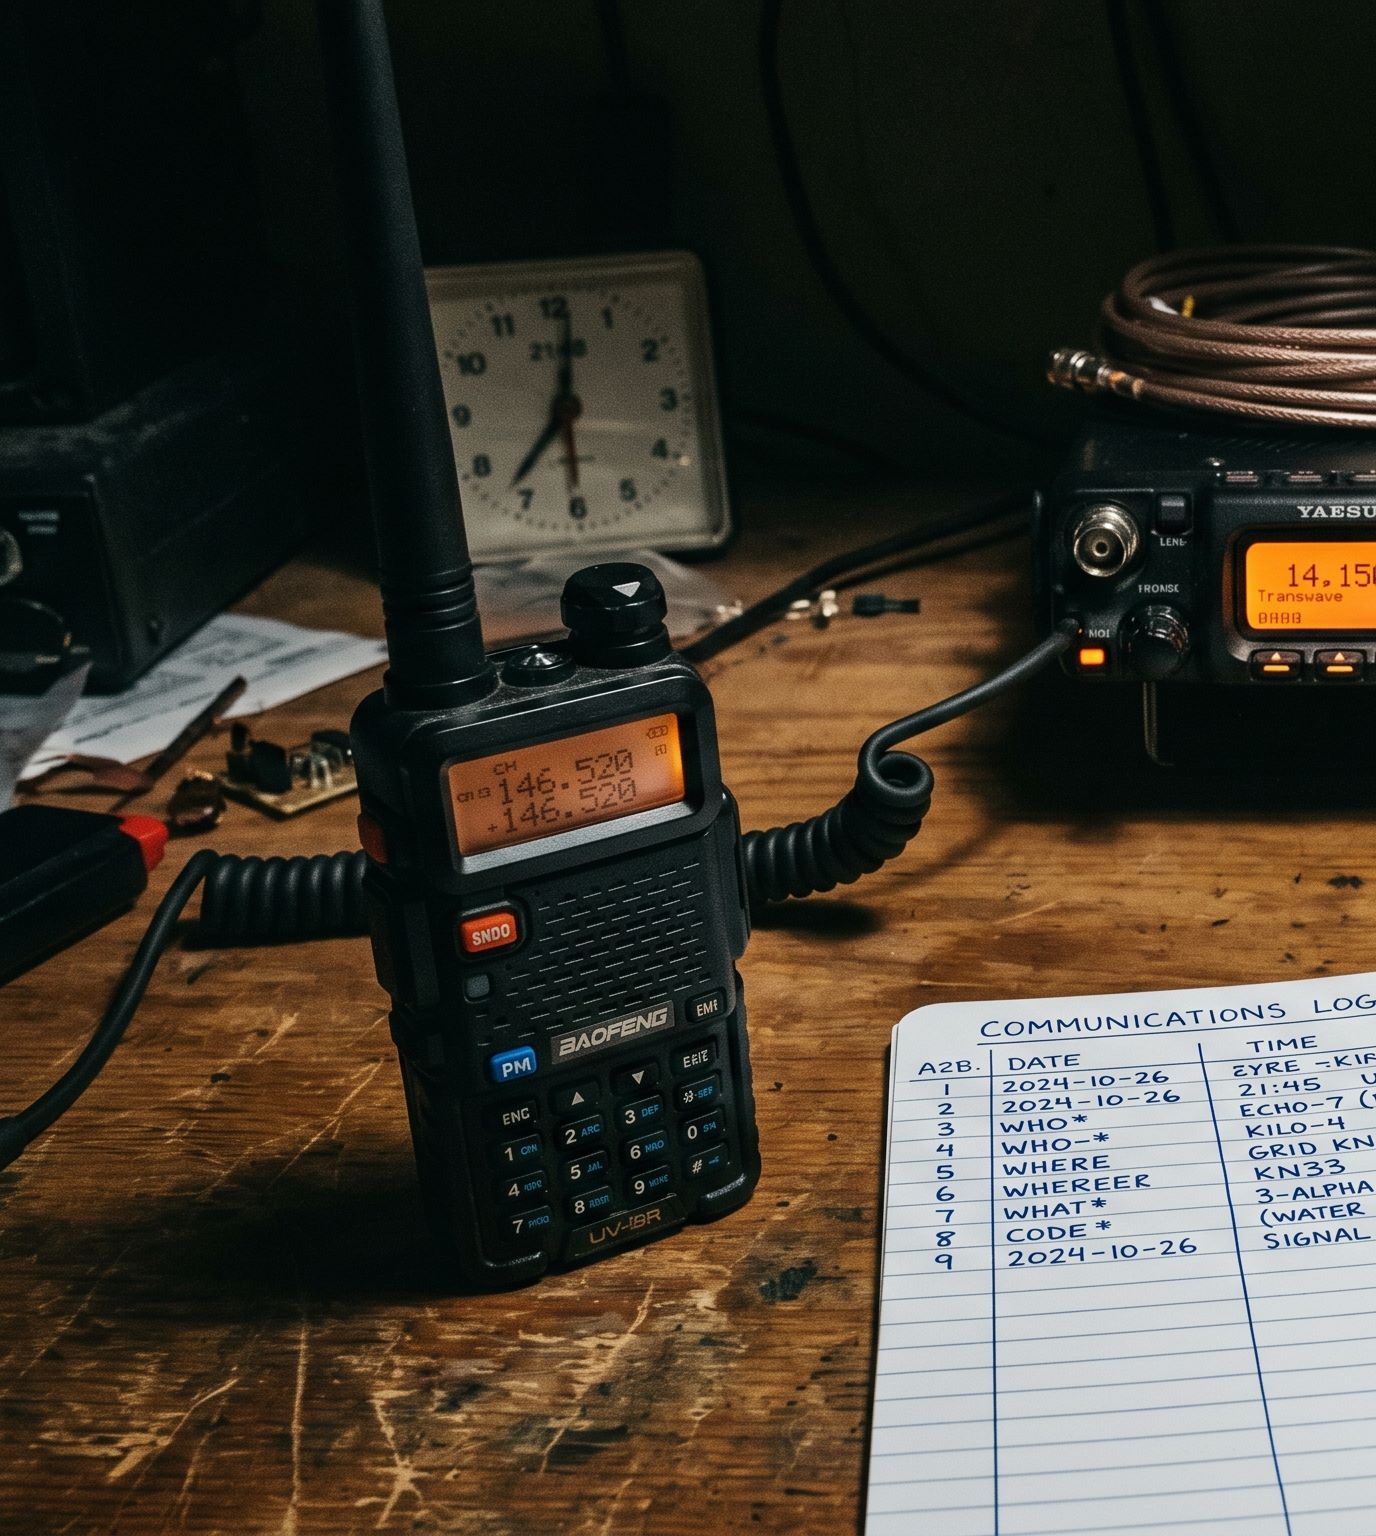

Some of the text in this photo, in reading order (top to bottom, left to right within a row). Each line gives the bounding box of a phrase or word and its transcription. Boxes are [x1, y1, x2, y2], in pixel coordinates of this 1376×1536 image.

[540, 297, 568, 319] 12
[603, 307, 613, 329] 1
[492, 314, 514, 337] 11
[641, 338, 659, 362] 2
[457, 352, 486, 376] 10
[660, 388, 678, 411] 3
[452, 404, 471, 427] 9
[651, 438, 668, 459] 4
[473, 454, 491, 477] 8
[518, 488, 534, 510] 7
[620, 478, 636, 502] 5
[569, 496, 587, 519] 6
[1258, 589, 1343, 602] Transwave
[492, 761, 517, 776] CH
[500, 749, 633, 805] 146.520
[472, 923, 511, 946] SNDO
[980, 1003, 1286, 1038] COMMUNICATIONS
[559, 1008, 668, 1056] BAOFENG
[1246, 1035, 1318, 1053] TIME
[502, 1057, 532, 1077] PM
[918, 1060, 981, 1076] A2B.
[1008, 1053, 1081, 1071] DATE
[1002, 1070, 1170, 1094] 2024-10-26
[1238, 1077, 1321, 1097] 21:45
[938, 1103, 955, 1116] 2
[1002, 1089, 1181, 1114] 2024-10-26
[1239, 1096, 1344, 1118] ECHO-7
[625, 1104, 659, 1124] 3 DEF
[565, 1129, 577, 1145] 2
[938, 1122, 955, 1137] 3
[1245, 1116, 1346, 1138] KILO-4
[504, 1148, 514, 1161] 1
[630, 1144, 641, 1160] 6
[936, 1144, 954, 1157] 4
[1248, 1142, 1317, 1160] GRID
[570, 1164, 581, 1180] 5
[936, 1165, 955, 1180] 5
[1002, 1155, 1111, 1176] WHERE
[1254, 1158, 1346, 1181] KN33
[508, 1183, 520, 1197] 4
[634, 1180, 645, 1195] 9
[935, 1186, 955, 1202] 6
[1003, 1174, 1151, 1198] WHEREER
[574, 1199, 585, 1214] 8
[935, 1209, 955, 1223] 7
[1260, 1201, 1365, 1228] (WATER
[512, 1219, 524, 1234] 7
[936, 1231, 956, 1248] 8
[1263, 1227, 1371, 1250] SIGNAL
[934, 1254, 953, 1270] 9
[1007, 1237, 1197, 1267] 2024-10-26
